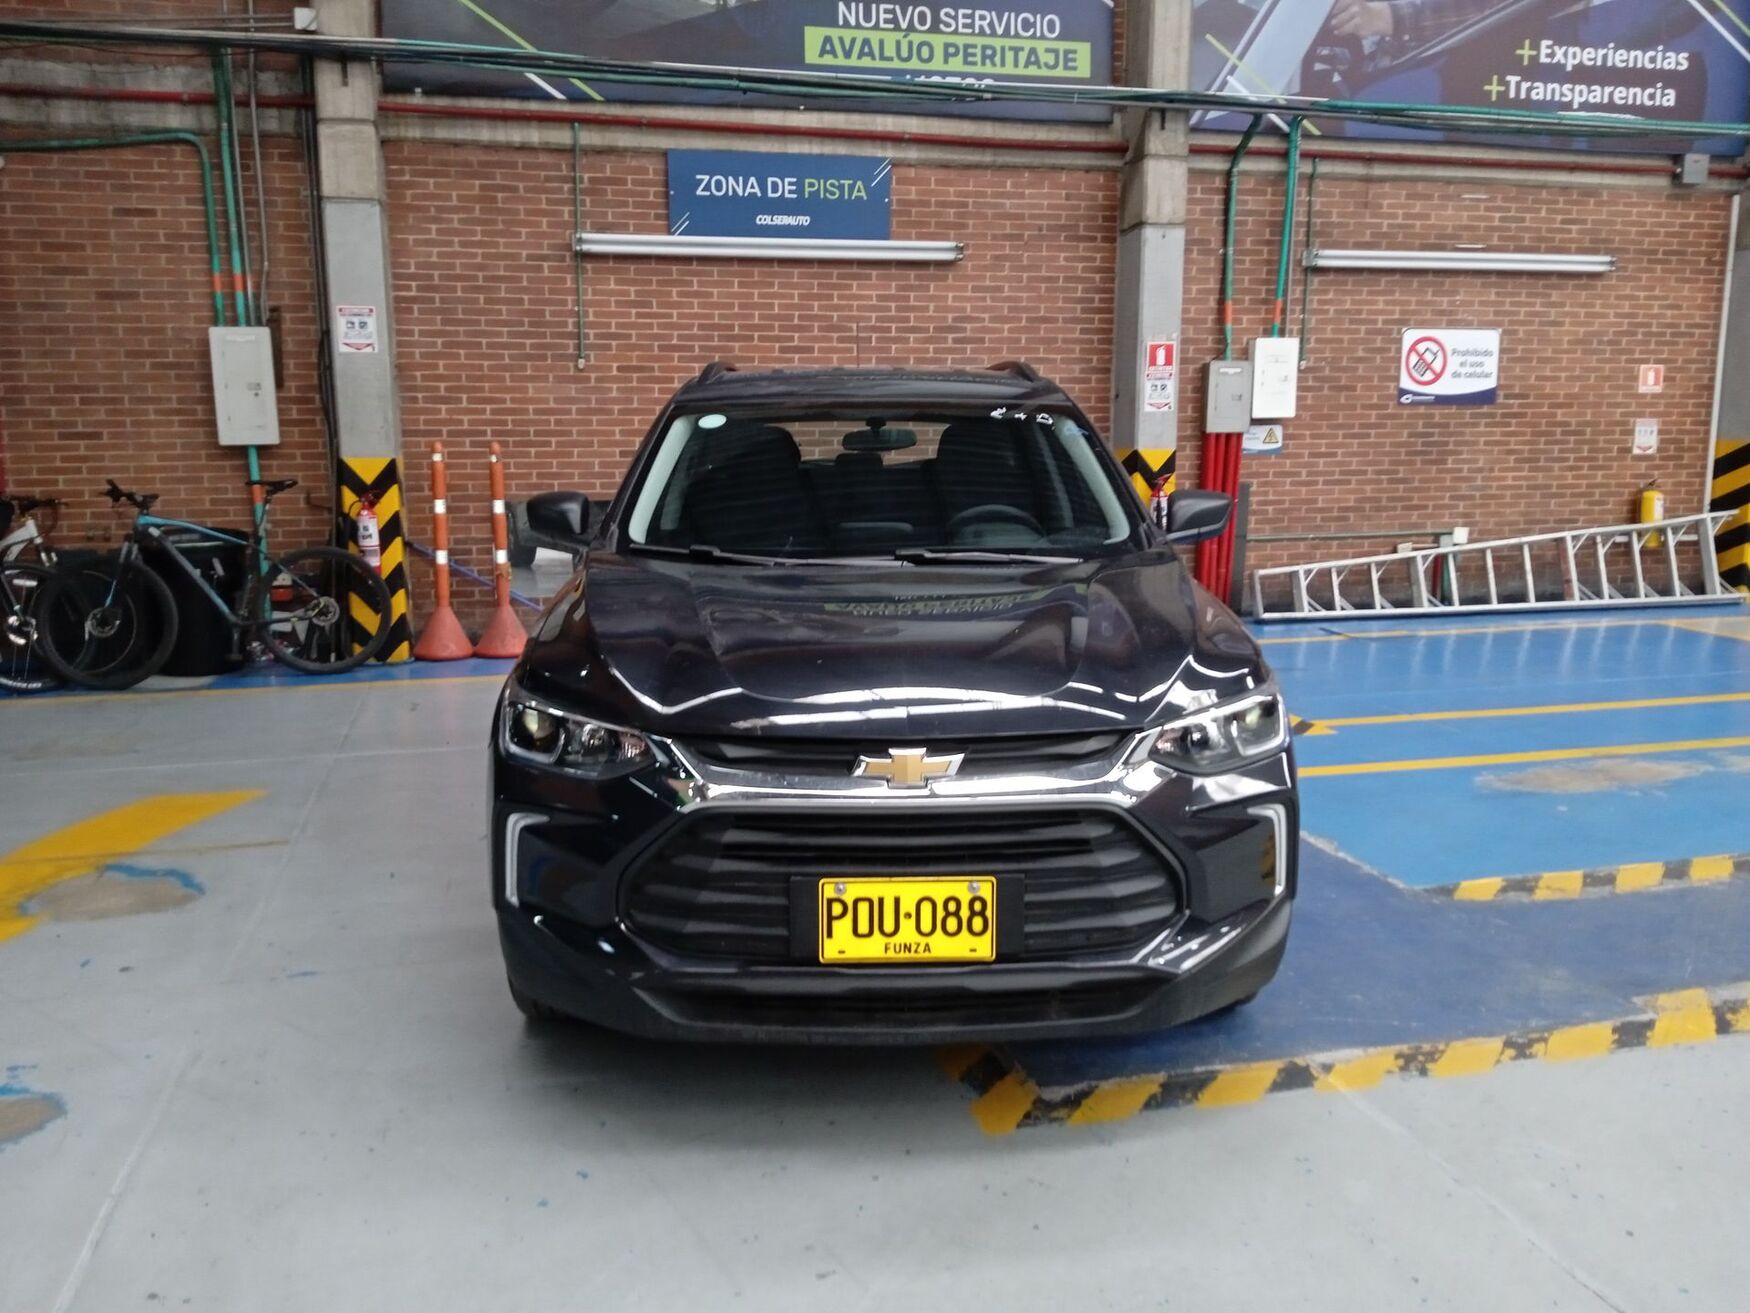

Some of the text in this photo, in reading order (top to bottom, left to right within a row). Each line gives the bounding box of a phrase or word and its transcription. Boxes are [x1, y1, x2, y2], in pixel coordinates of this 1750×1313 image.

[837, 1, 1061, 39] NUEVO SERVICIO
[817, 33, 1079, 72] AVALÚO PERITAJE
[695, 174, 868, 201] ZONA DE PISTA
[884, 942, 932, 955] FUNZA
